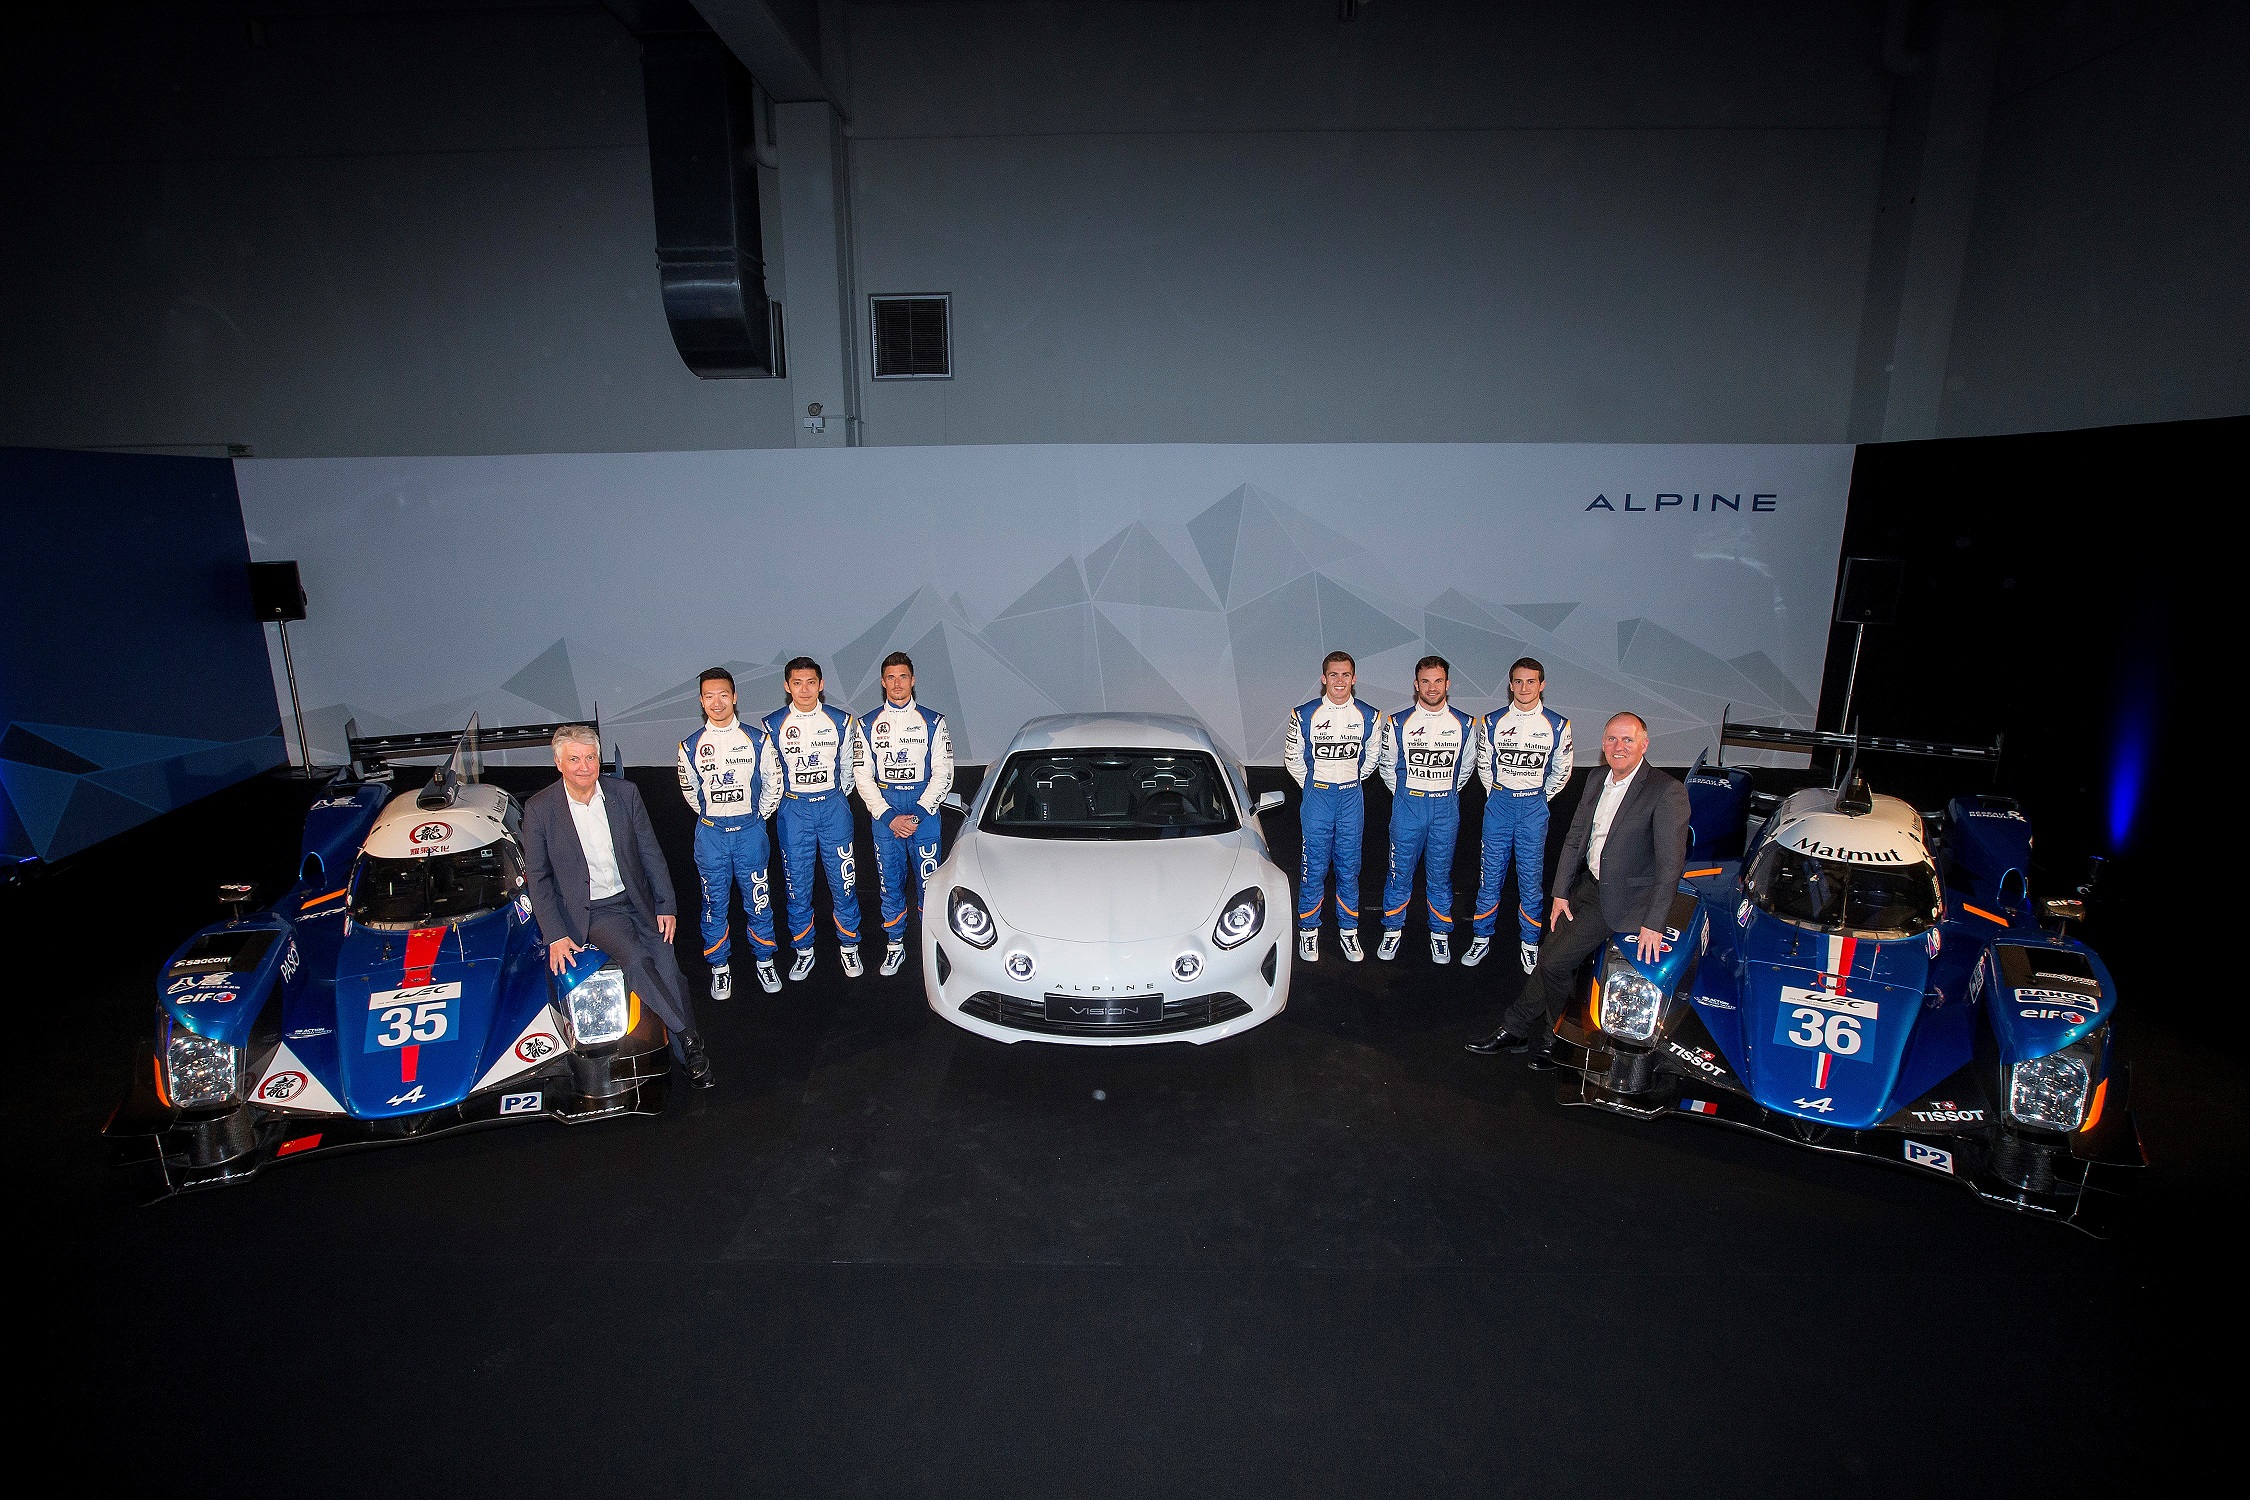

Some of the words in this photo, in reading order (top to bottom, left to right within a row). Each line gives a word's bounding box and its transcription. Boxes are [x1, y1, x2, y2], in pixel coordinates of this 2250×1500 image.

[1584, 493, 1778, 512] ALPINE
[1316, 744, 1343, 758] elf
[1410, 751, 1438, 765] elf
[725, 757, 752, 765] Matmut
[1500, 752, 1528, 766] elf
[796, 774, 817, 783] elf
[886, 769, 906, 778] elf
[1408, 767, 1452, 779] Matmut
[712, 792, 732, 802] elf
[1792, 838, 1903, 862] Matmut
[393, 985, 449, 999] WEC
[1055, 983, 1154, 991] ALPINE
[176, 992, 215, 1004] elf
[1805, 994, 1864, 1008] WEC
[2020, 990, 2088, 1002] BAHCO
[1069, 1007, 1139, 1015] VISION
[2020, 1009, 2060, 1018] elf
[378, 1002, 447, 1046] 35
[1788, 1008, 1861, 1054] 36
[1669, 1042, 1726, 1076] TISSOT
[505, 1096, 537, 1110] P2
[1912, 1110, 1983, 1121] TISSOT
[1910, 1144, 1948, 1169] P2
